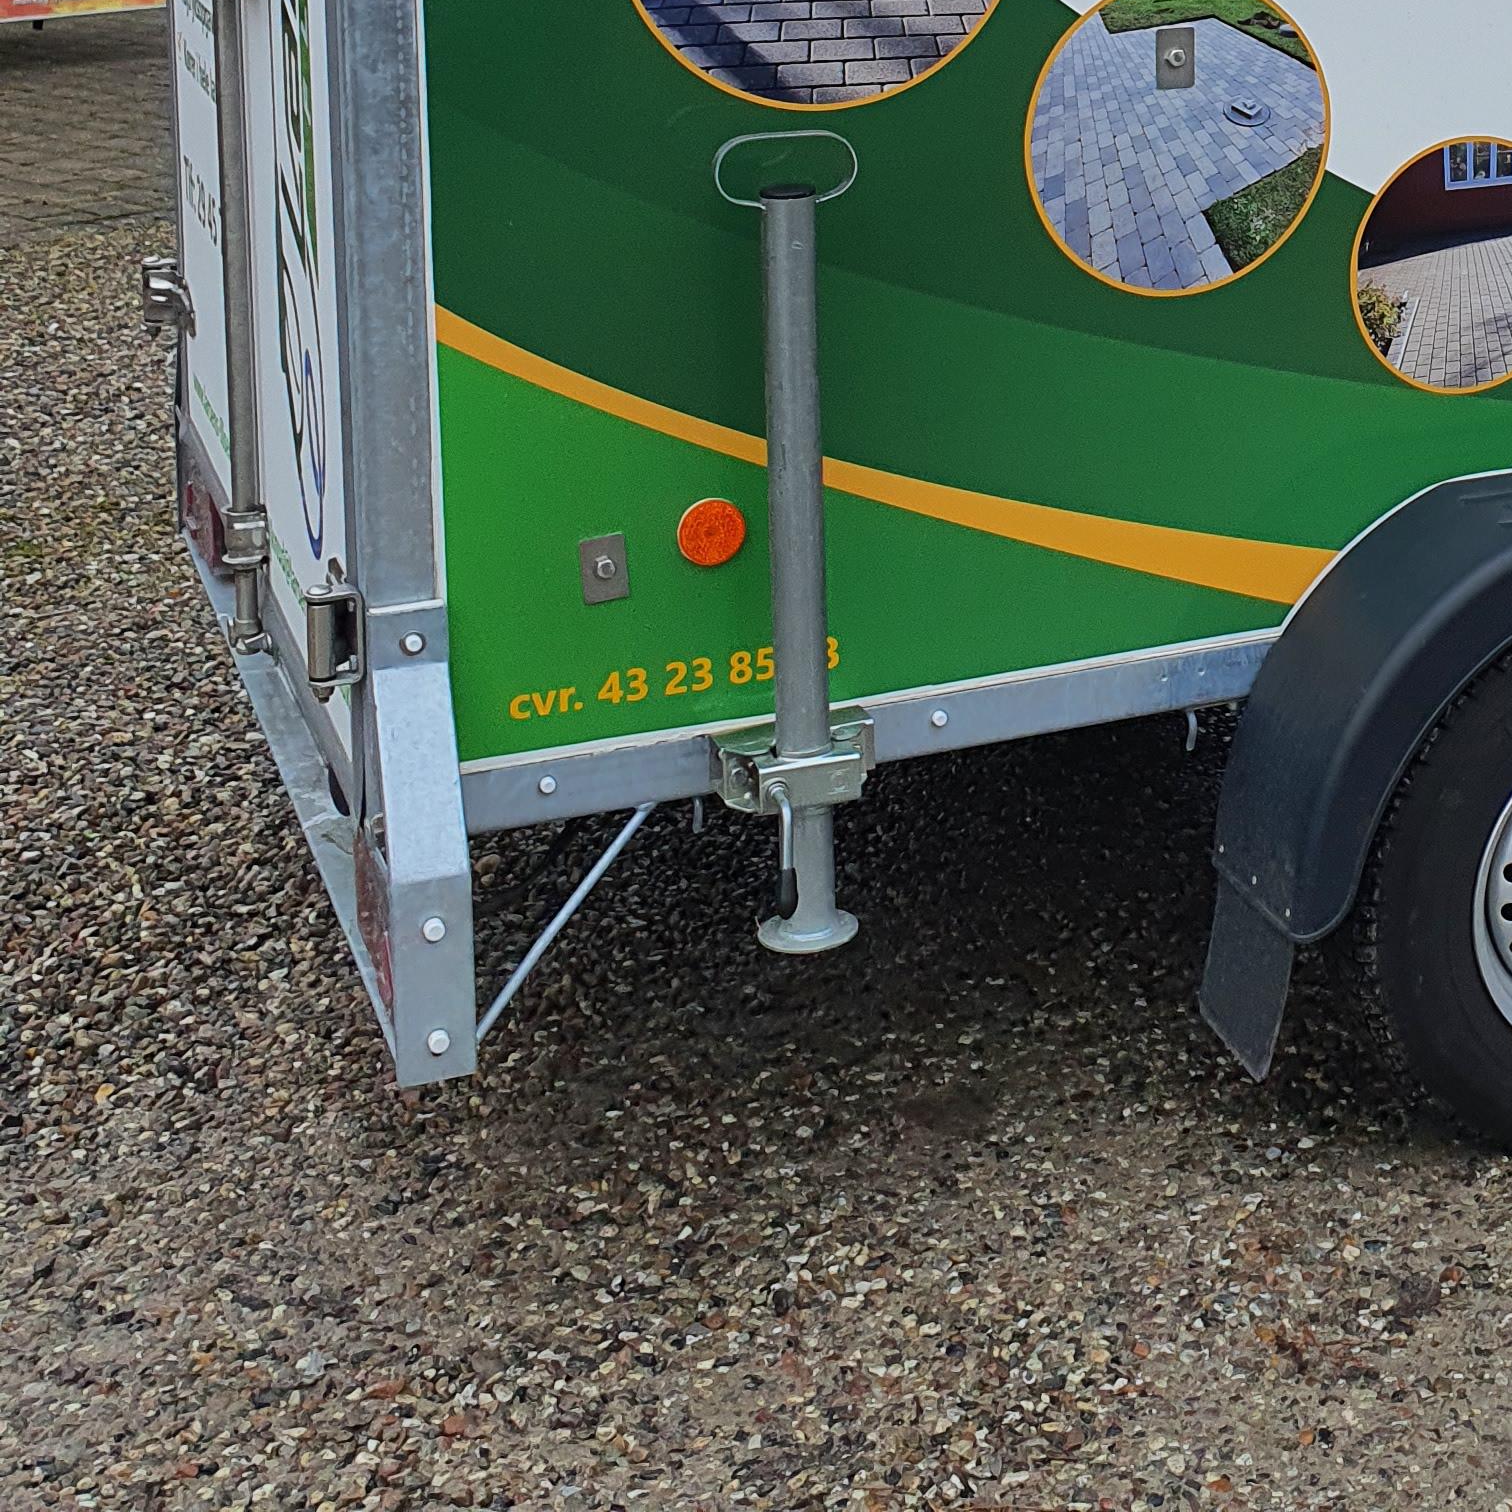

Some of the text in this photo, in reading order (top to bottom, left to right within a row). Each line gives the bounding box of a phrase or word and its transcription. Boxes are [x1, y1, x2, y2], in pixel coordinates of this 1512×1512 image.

[509, 688, 582, 719] cvr.
[598, 668, 648, 703] 43
[665, 658, 713, 696] 23
[729, 647, 774, 684] 85
